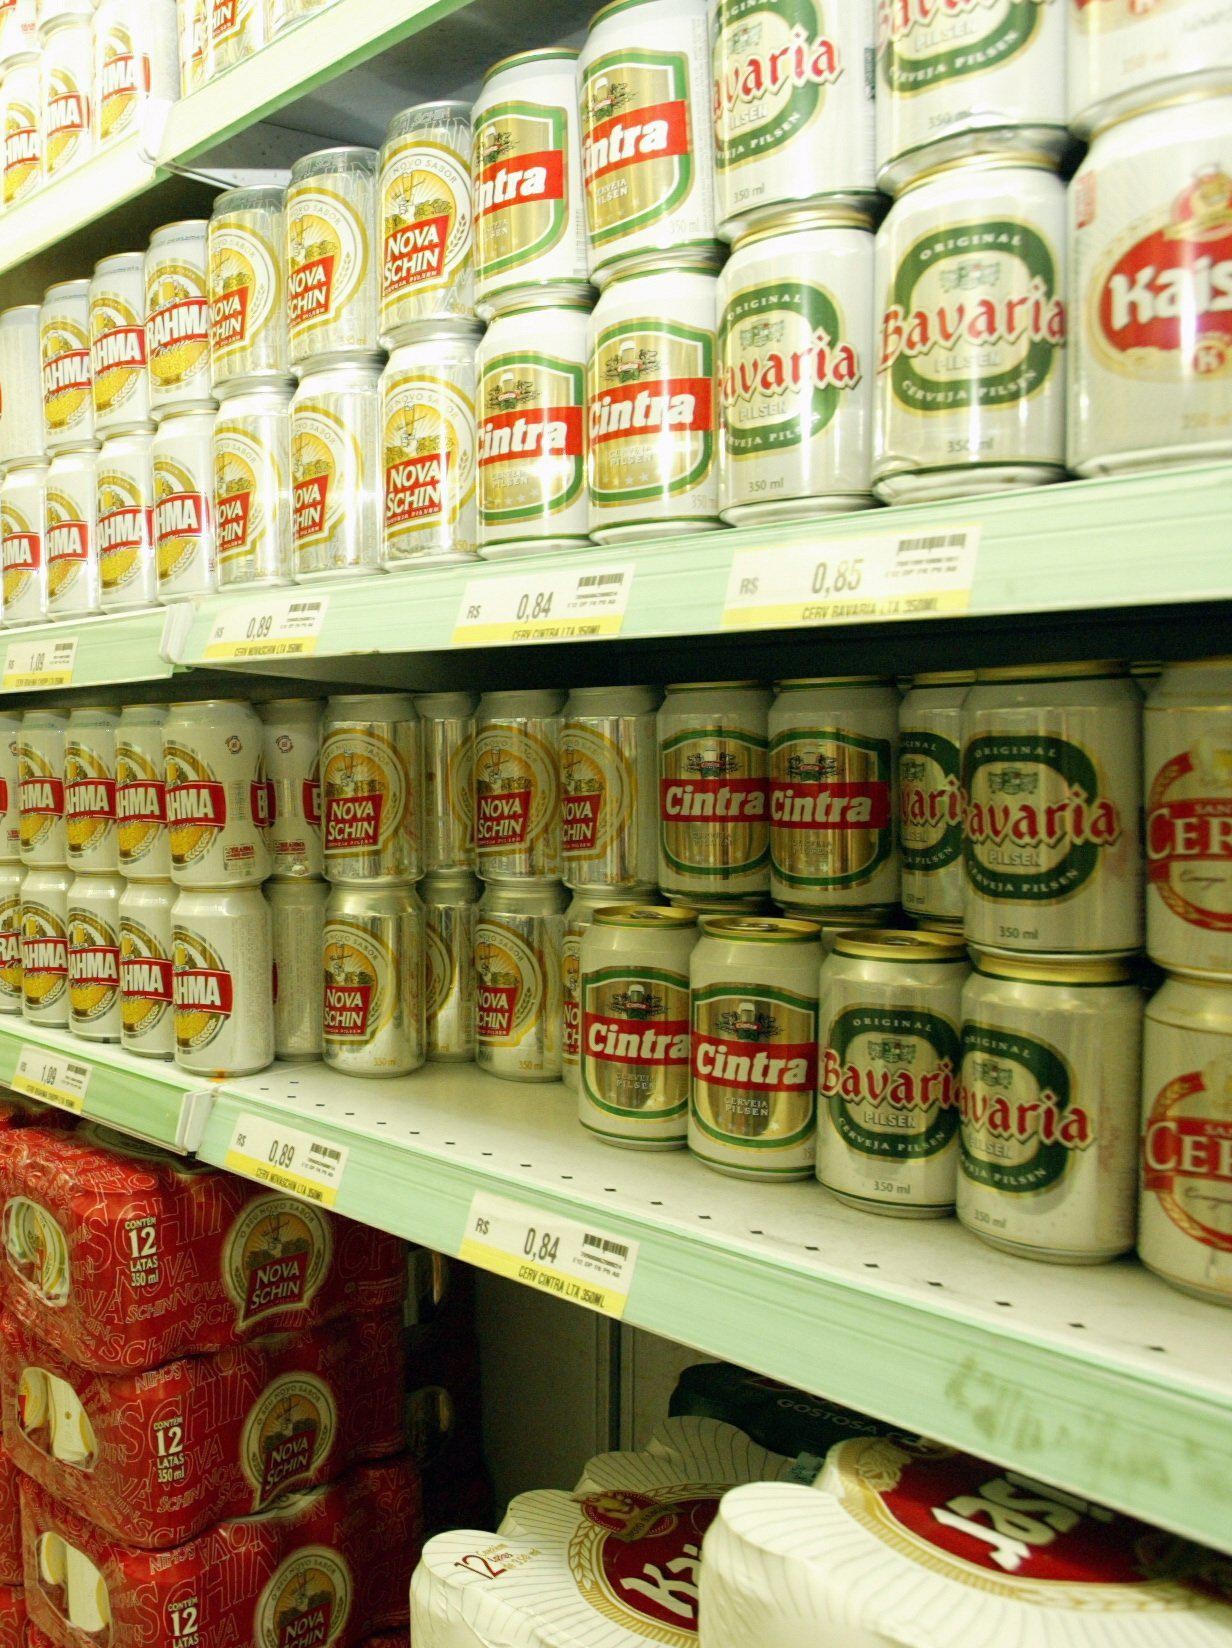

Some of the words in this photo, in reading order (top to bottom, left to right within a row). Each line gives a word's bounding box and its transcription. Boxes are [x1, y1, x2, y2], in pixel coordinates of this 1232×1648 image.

[954, 31, 1018, 69] PILSEN
[750, 112, 801, 149] PILSEN
[734, 189, 750, 202] 350
[752, 183, 765, 196] ml
[387, 224, 439, 259] NOVA
[919, 231, 1022, 260] ORIGINAL
[384, 248, 439, 287] SCHIN
[727, 294, 802, 321] ORIGINAL
[878, 276, 1066, 376] Bavaria
[902, 380, 968, 403] CERVEJA
[589, 390, 695, 437] Cintra
[389, 458, 441, 491] NOVA
[748, 479, 766, 493] 350
[770, 477, 785, 490] ml
[386, 484, 442, 517] SCHIN
[812, 558, 864, 597] 0,85
[517, 591, 554, 624] 0,84
[832, 601, 876, 619] BAVARIA
[246, 615, 273, 642] 0,89
[331, 801, 374, 820] NOVA
[480, 797, 522, 818] NOVA
[665, 784, 765, 817] Cintra
[770, 789, 873, 823] Cintra
[328, 821, 375, 841] SCHIN
[478, 818, 523, 839] SCHIN
[988, 849, 1042, 868] PILSEN
[1022, 868, 1079, 893] PILSEN
[999, 925, 1019, 939] 350
[1022, 925, 1039, 940] ml
[326, 989, 363, 1008] NOVA
[324, 1011, 364, 1029] SCHIN
[852, 1018, 933, 1032] ORIGINAL
[588, 1023, 689, 1060] Cintra
[696, 1042, 809, 1086] Cintra
[725, 1097, 768, 1108] CERVEJA
[725, 1104, 769, 1116] PILSEN
[838, 1117, 890, 1151] CERVEJA
[898, 1131, 945, 1151] PILSEN
[865, 1111, 917, 1129] PILSEN
[268, 1139, 295, 1169] 0,89
[873, 1180, 894, 1194] 350
[896, 1183, 911, 1195] ml
[994, 1167, 1048, 1186] PILSEN
[974, 1208, 991, 1224] 350
[991, 1213, 1008, 1229] ml
[129, 1227, 157, 1258] 12
[475, 1217, 490, 1235] R$
[524, 1227, 560, 1263] 0,84
[130, 1257, 158, 1272] LATAS
[256, 1260, 300, 1289] NOVA
[131, 1271, 145, 1287] 350
[146, 1271, 159, 1284] ml
[518, 1265, 539, 1283] CERV
[538, 1271, 564, 1294] CINTRA
[565, 1281, 581, 1300] LTA
[251, 1281, 300, 1309] SCHIN
[775, 1397, 881, 1437] GOSTOSA
[156, 1426, 184, 1457] 12
[270, 1437, 309, 1468] NOVA
[157, 1454, 185, 1470] LATAS
[157, 1467, 173, 1483] 350
[173, 1467, 185, 1481] ml
[266, 1454, 309, 1490] SCHIN
[454, 1554, 506, 1580] 12
[171, 1607, 199, 1637] 12
[285, 1613, 325, 1642] NOVA
